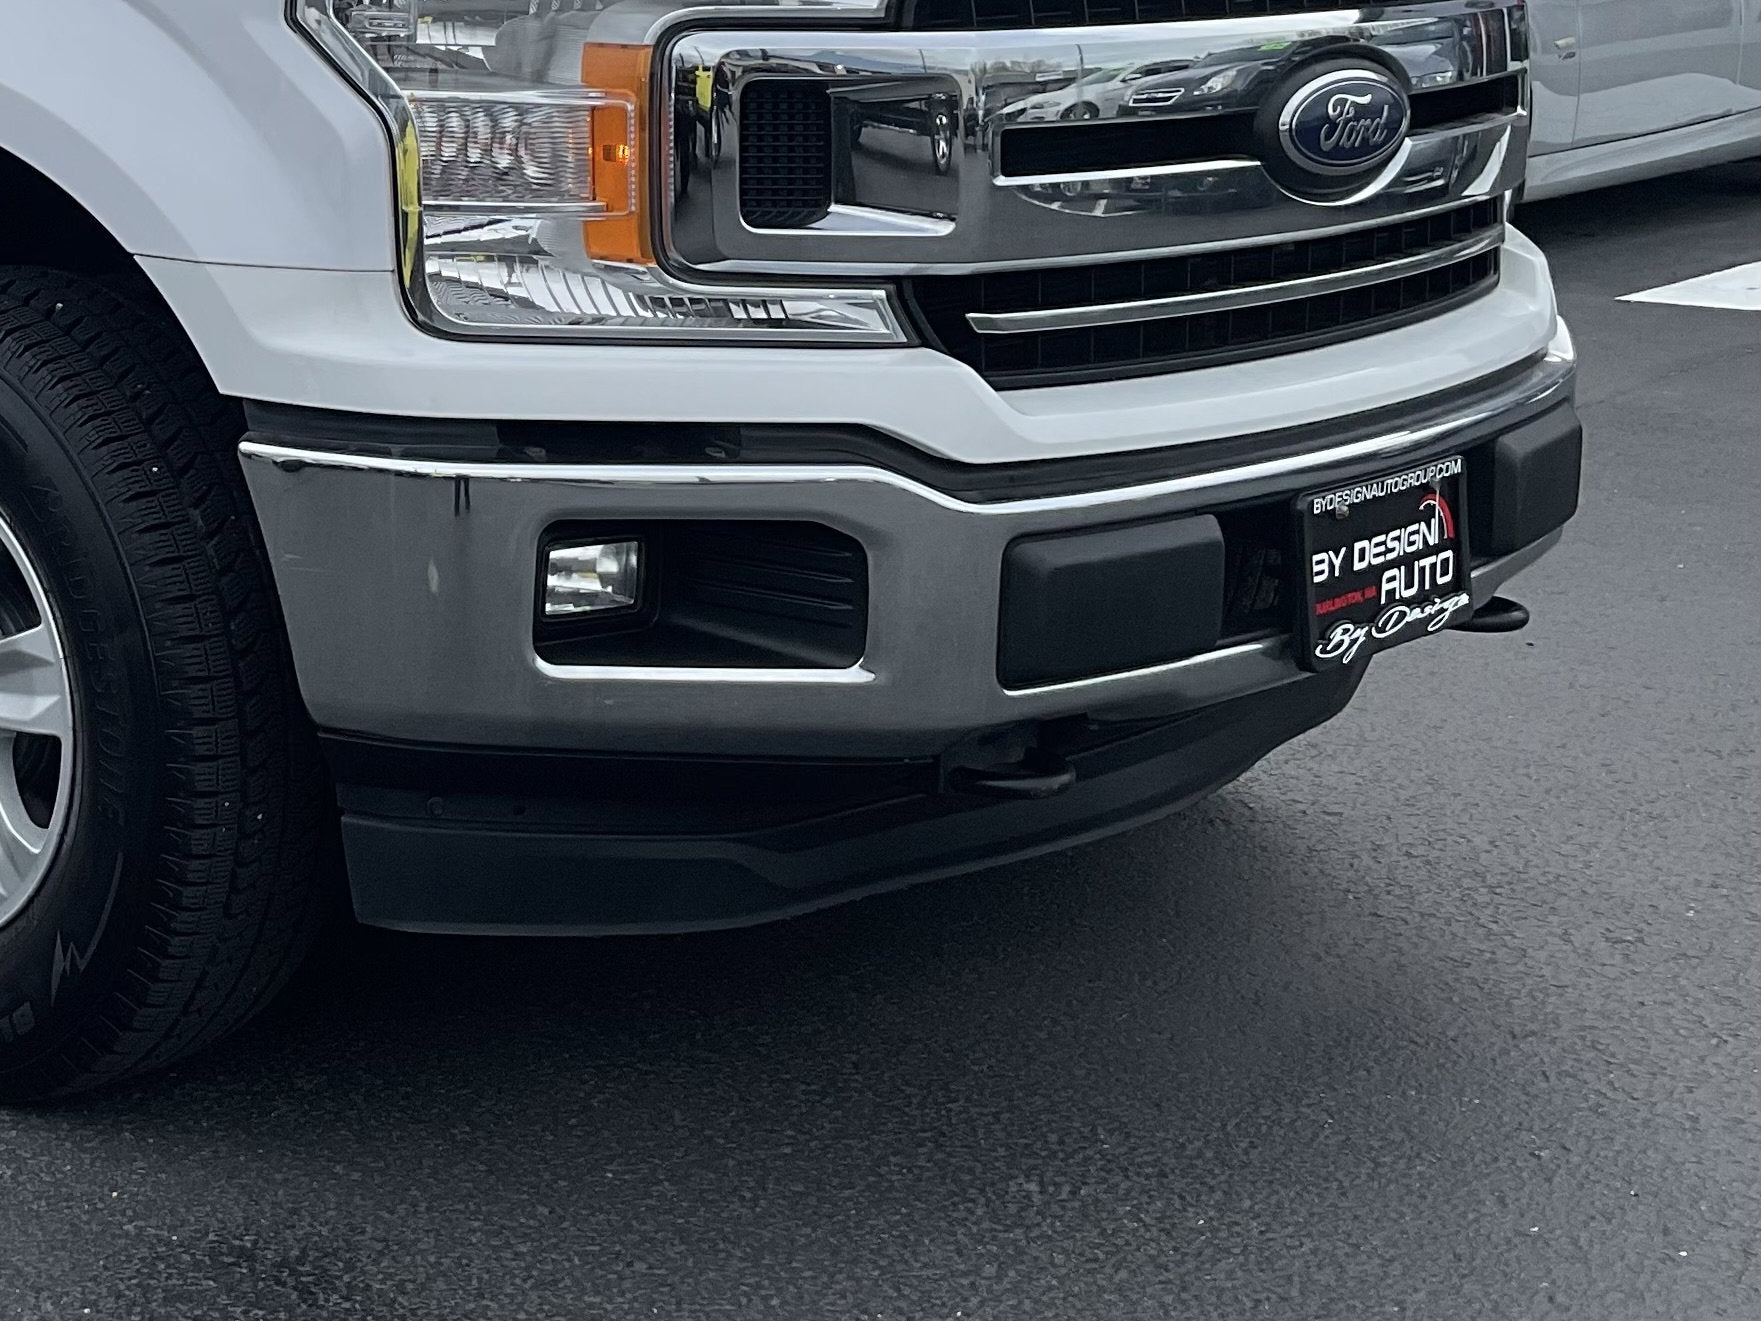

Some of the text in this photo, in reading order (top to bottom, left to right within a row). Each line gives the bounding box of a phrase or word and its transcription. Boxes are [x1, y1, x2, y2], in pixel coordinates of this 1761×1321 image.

[1319, 93, 1389, 152] Ford
[1312, 518, 1439, 583] BY DESIGN
[1380, 549, 1453, 604] AUTO
[1314, 592, 1470, 664] By Design
